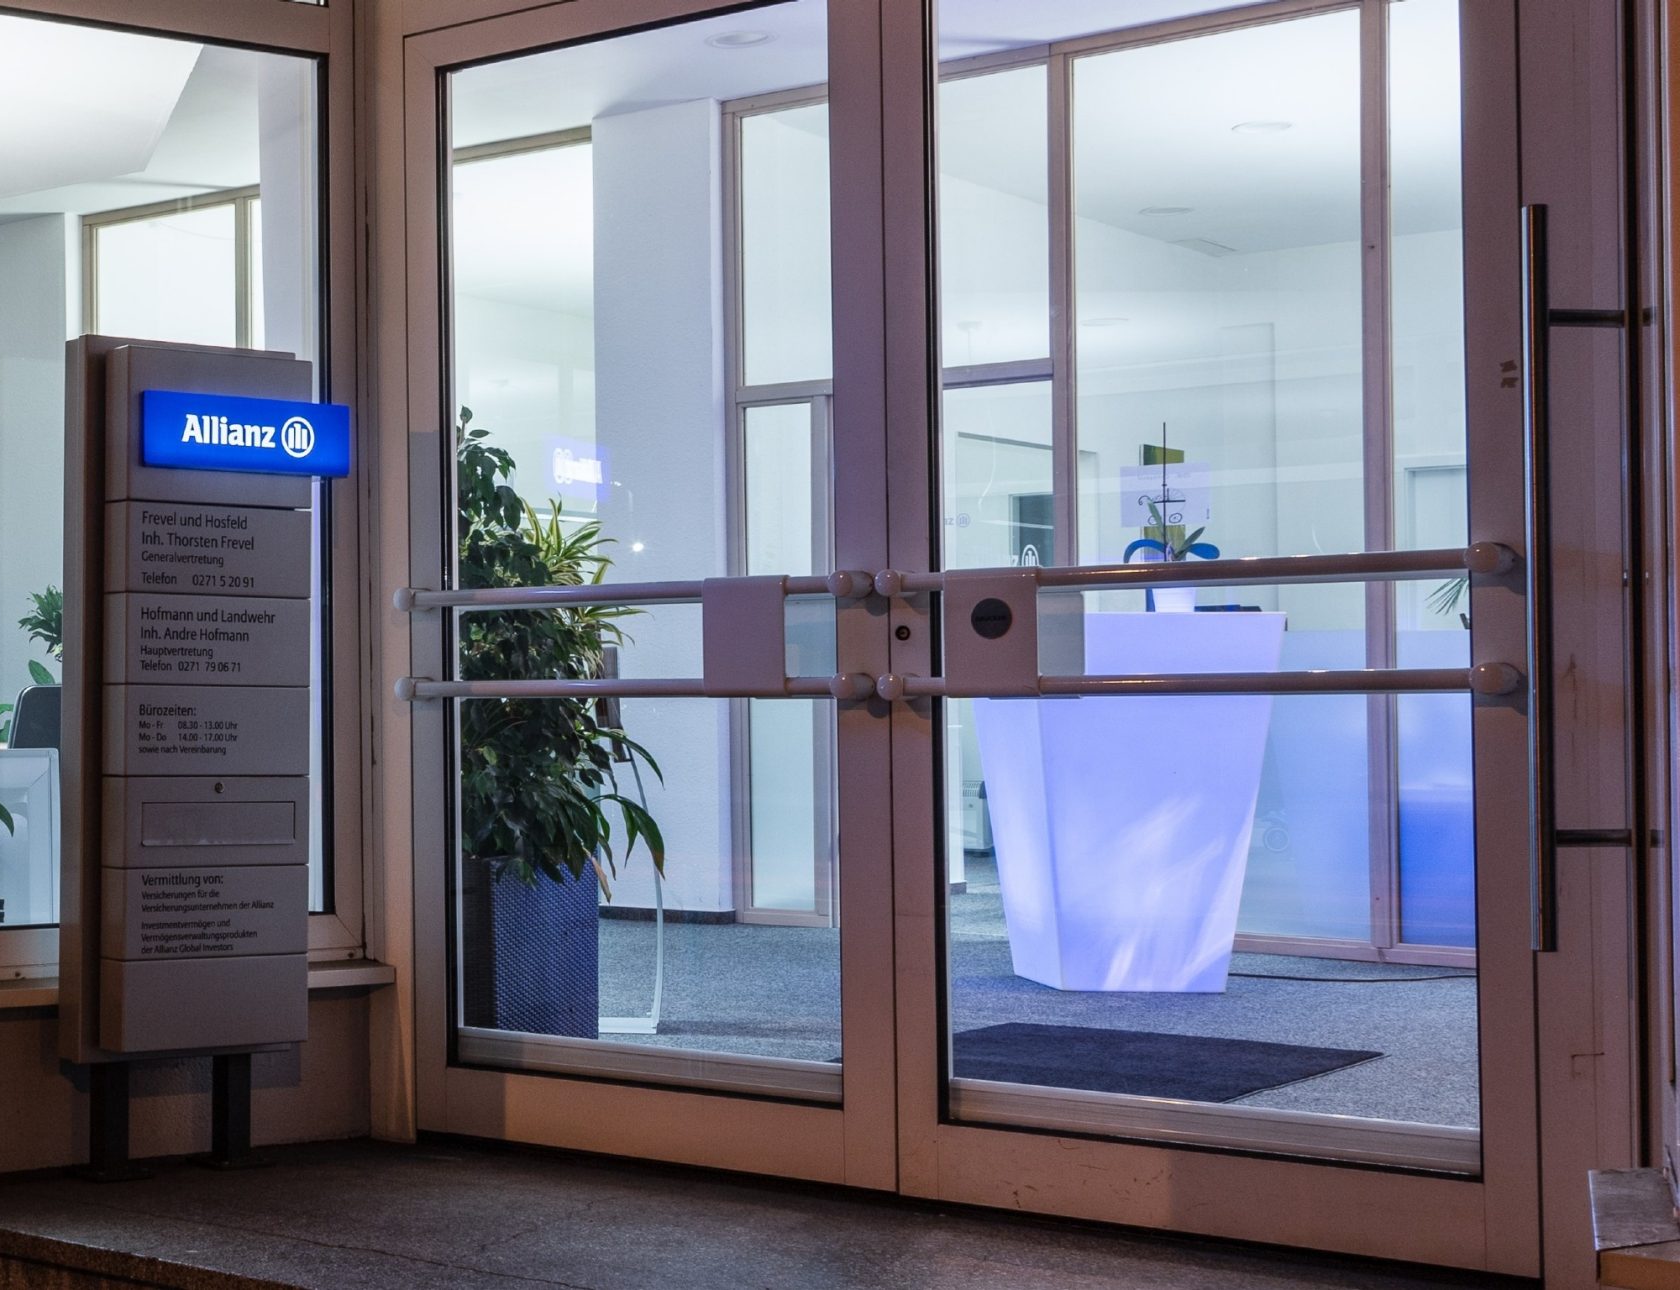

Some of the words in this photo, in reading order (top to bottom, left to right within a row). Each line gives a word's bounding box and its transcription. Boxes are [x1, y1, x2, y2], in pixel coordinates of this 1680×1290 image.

[181, 413, 276, 449] Allianz
[142, 511, 177, 526] Frevel
[180, 513, 202, 527] und
[205, 514, 248, 530] Hosfeld
[142, 531, 165, 546] Inh.
[167, 532, 218, 549] Thorsten
[221, 535, 255, 550] Frevel
[141, 550, 224, 568] Generalvertretung
[142, 571, 177, 585] Telefon
[192, 574, 217, 587] 0271
[219, 575, 226, 587] 5
[228, 576, 241, 588] 20
[243, 576, 255, 588] 91
[141, 606, 194, 621] Hofmann
[196, 608, 218, 622] und
[221, 609, 276, 624] Landwehr
[140, 626, 162, 640] Inh.
[164, 627, 197, 641] Andre
[200, 628, 250, 642] Hofmann
[140, 645, 214, 660] Hauptvertretung
[140, 659, 172, 671] Telefon
[178, 661, 200, 672] 0271
[205, 661, 216, 672] 79
[218, 661, 229, 672] 06
[231, 662, 241, 672] 71
[139, 704, 197, 717] Bürozeiten:
[161, 744, 178, 754] nach
[141, 873, 201, 888] Vermittlung
[203, 875, 224, 885] von:
[141, 890, 197, 901] Versicherungen
[209, 888, 220, 898] die
[251, 900, 274, 910] Allianz
